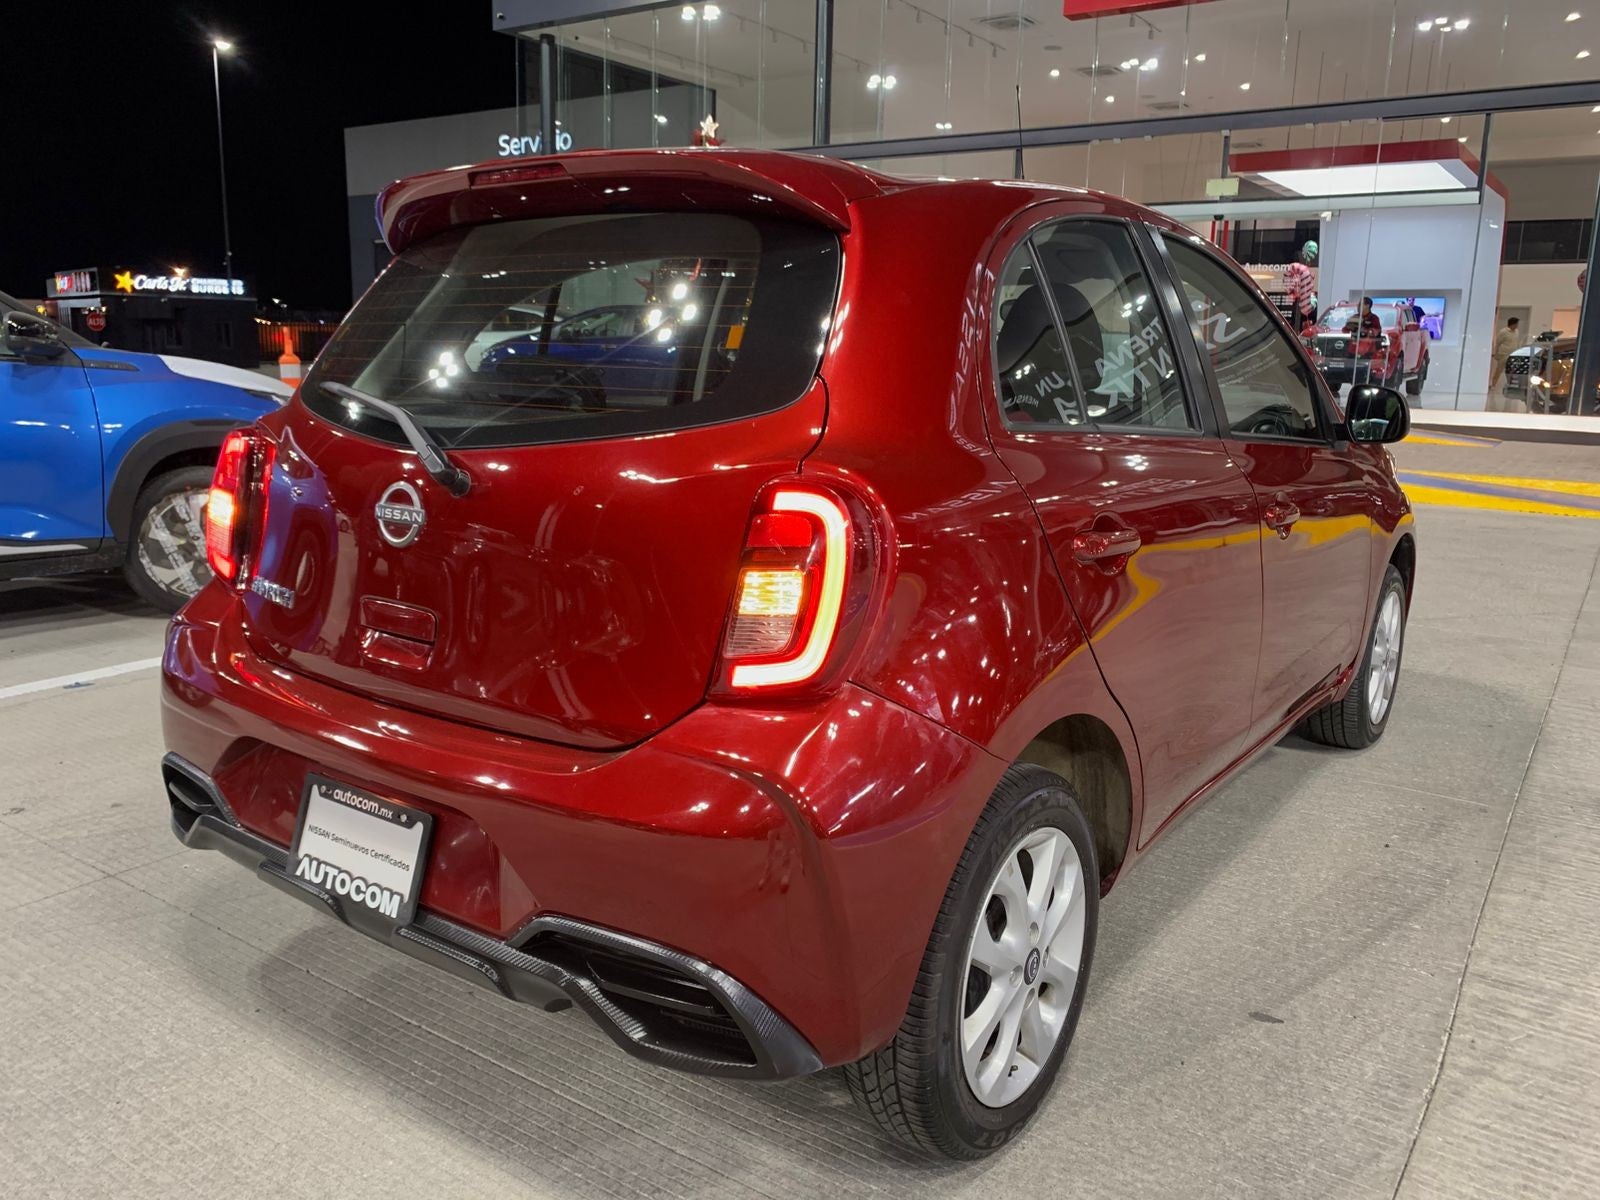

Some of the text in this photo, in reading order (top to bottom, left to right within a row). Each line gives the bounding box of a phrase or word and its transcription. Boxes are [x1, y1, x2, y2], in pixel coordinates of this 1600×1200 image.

[498, 128, 573, 156] Serviio
[1243, 262, 1291, 272] Autocom
[88, 318, 105, 326] ALTO
[376, 506, 423, 523] NISSAN
[333, 788, 394, 820] autocom.mx
[308, 824, 410, 872] NISSAN Seminuevos Certificados
[295, 855, 401, 919] AUTOCOM
